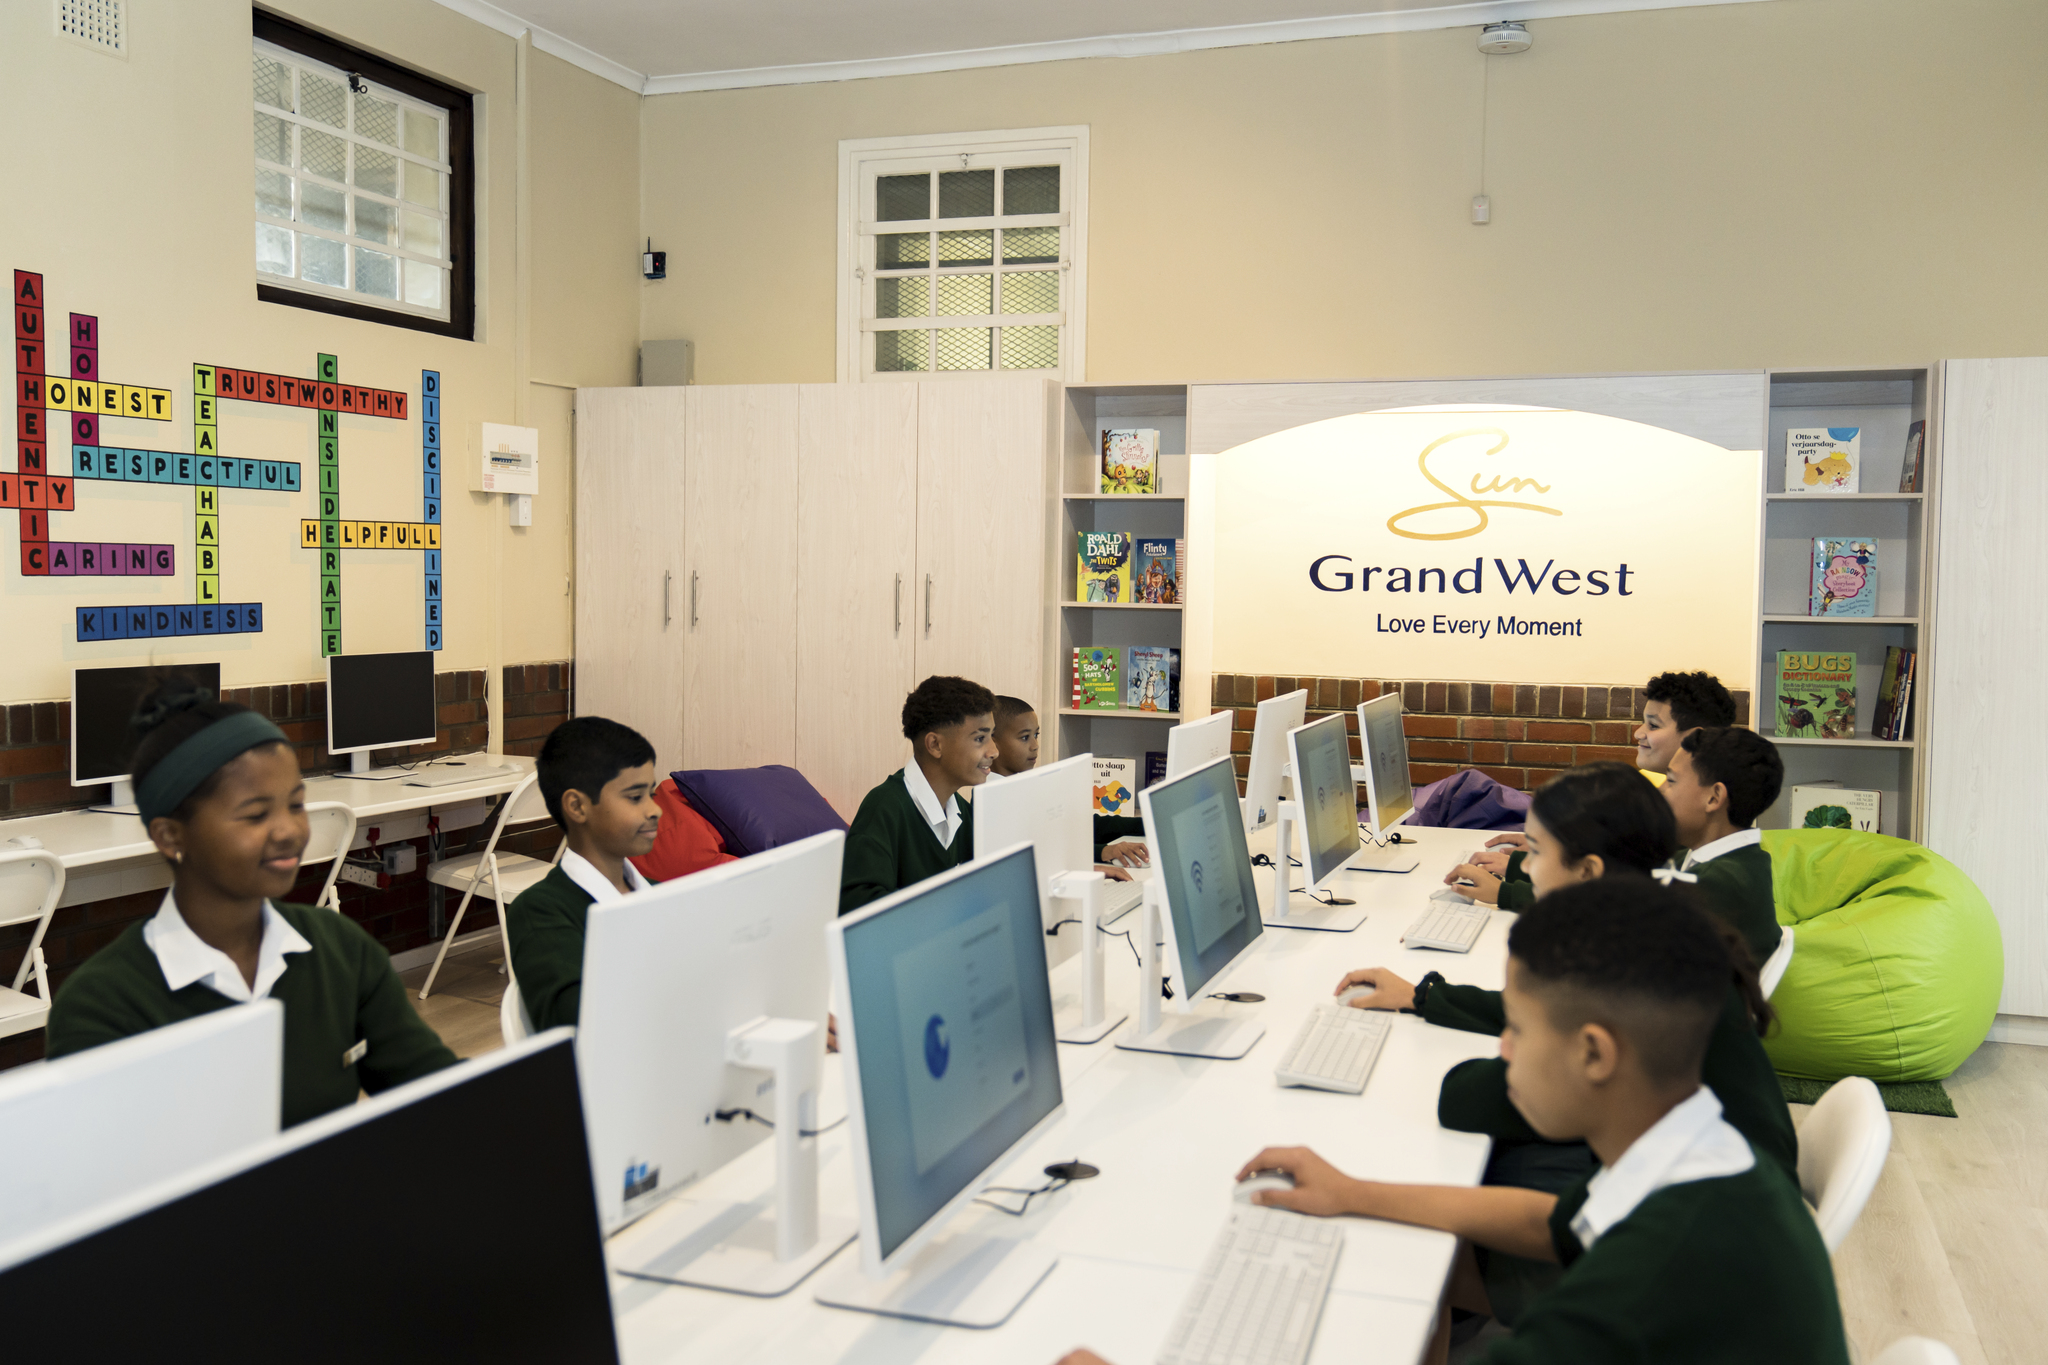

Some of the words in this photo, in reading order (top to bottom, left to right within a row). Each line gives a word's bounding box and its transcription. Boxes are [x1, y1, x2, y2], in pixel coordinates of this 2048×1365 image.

[24, 379, 166, 415] HONEST
[77, 320, 93, 471] HONOR
[197, 369, 404, 408] TRUSTWORTHY
[20, 278, 43, 570] AUTHENTIC
[1797, 448, 1817, 456] party
[80, 451, 295, 486] RESPECTFUL
[1387, 427, 1563, 541] Sun
[197, 369, 213, 628] TEACHABLE
[323, 360, 337, 652] CONSIDERATE
[426, 376, 439, 647] DISCIPLINED
[306, 524, 437, 546] HELPFULL
[1087, 533, 1122, 544] ROALD
[28, 547, 170, 570] CARING
[1087, 544, 1122, 556] DAHL
[1096, 556, 1117, 565] TWITS
[1143, 543, 1167, 556] Flinty
[83, 608, 258, 634] KINDNESS
[1377, 613, 1426, 633] Love
[1432, 614, 1491, 639] Every
[1497, 616, 1583, 637] Moment
[1083, 664, 1098, 672] 500
[1784, 654, 1852, 671] BUGS
[1783, 671, 1852, 682] DICTIONARY
[1092, 761, 1104, 769] tto
[1105, 761, 1126, 771] slaap
